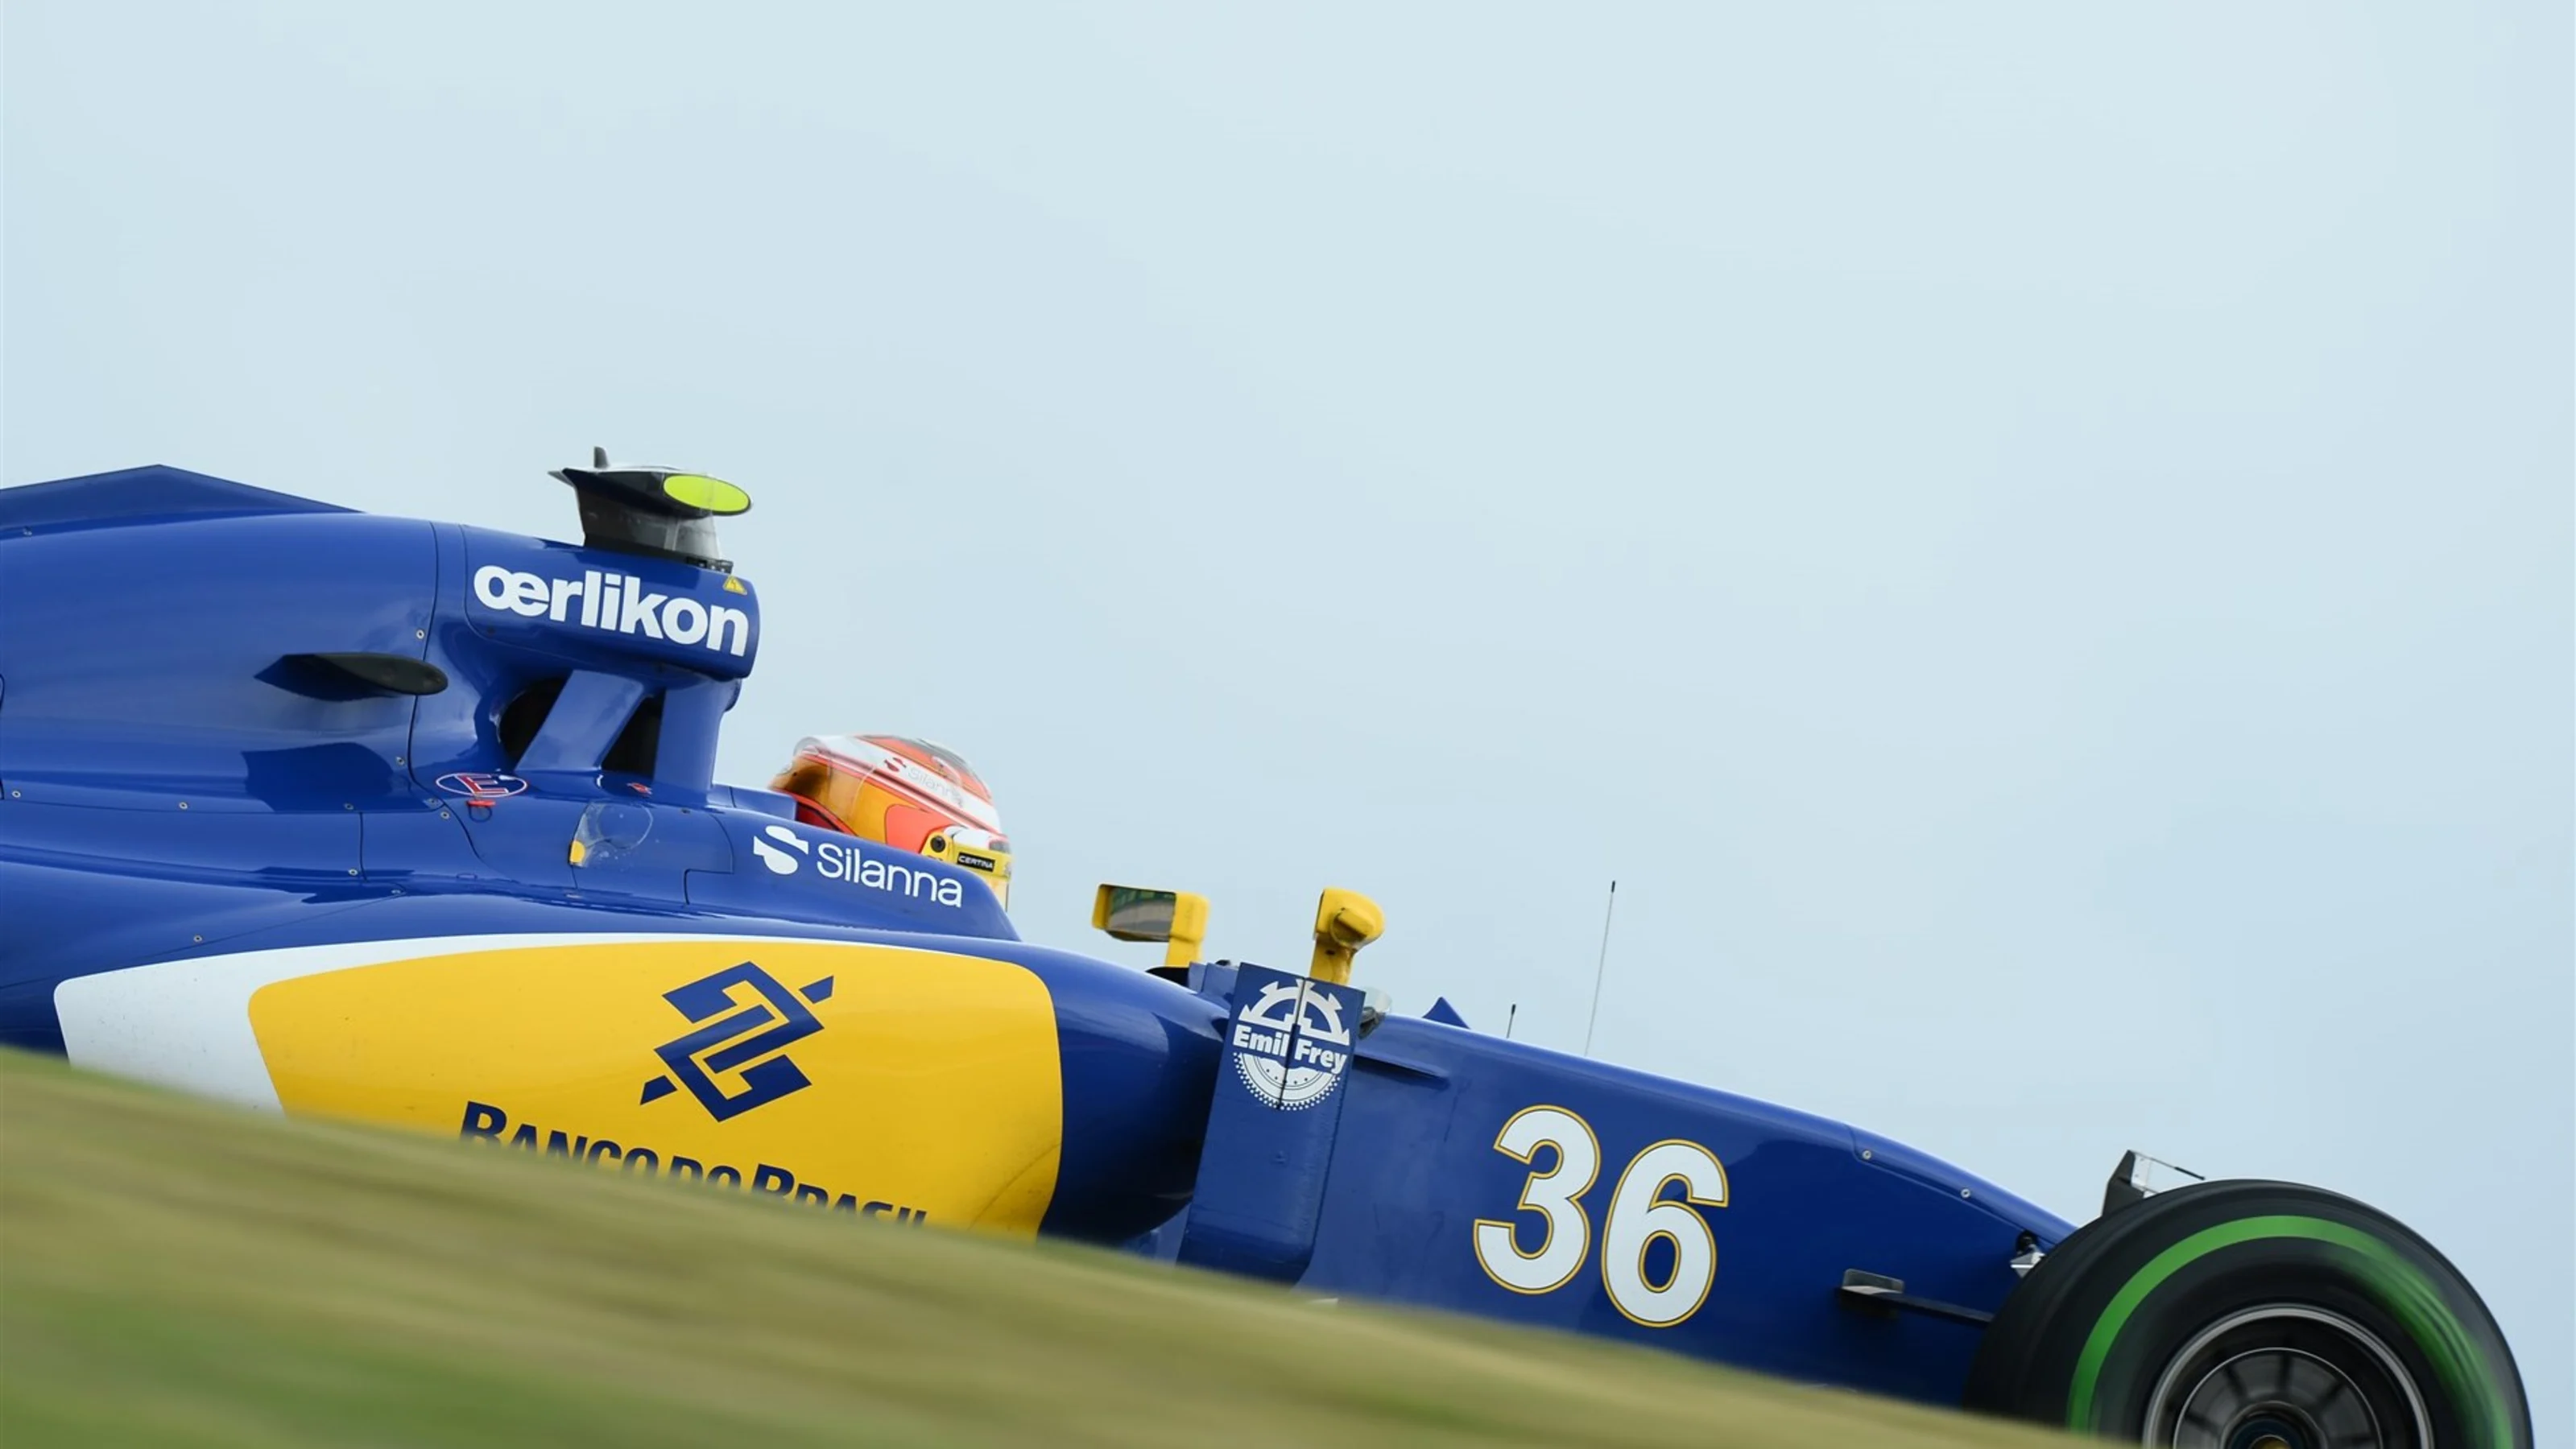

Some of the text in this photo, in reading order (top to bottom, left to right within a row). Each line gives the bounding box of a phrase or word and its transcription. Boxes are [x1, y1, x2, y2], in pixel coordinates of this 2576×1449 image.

[817, 843, 963, 908] Silanna
[1233, 1024, 1347, 1075] Emil Frey
[1473, 1104, 1730, 1328] 36
